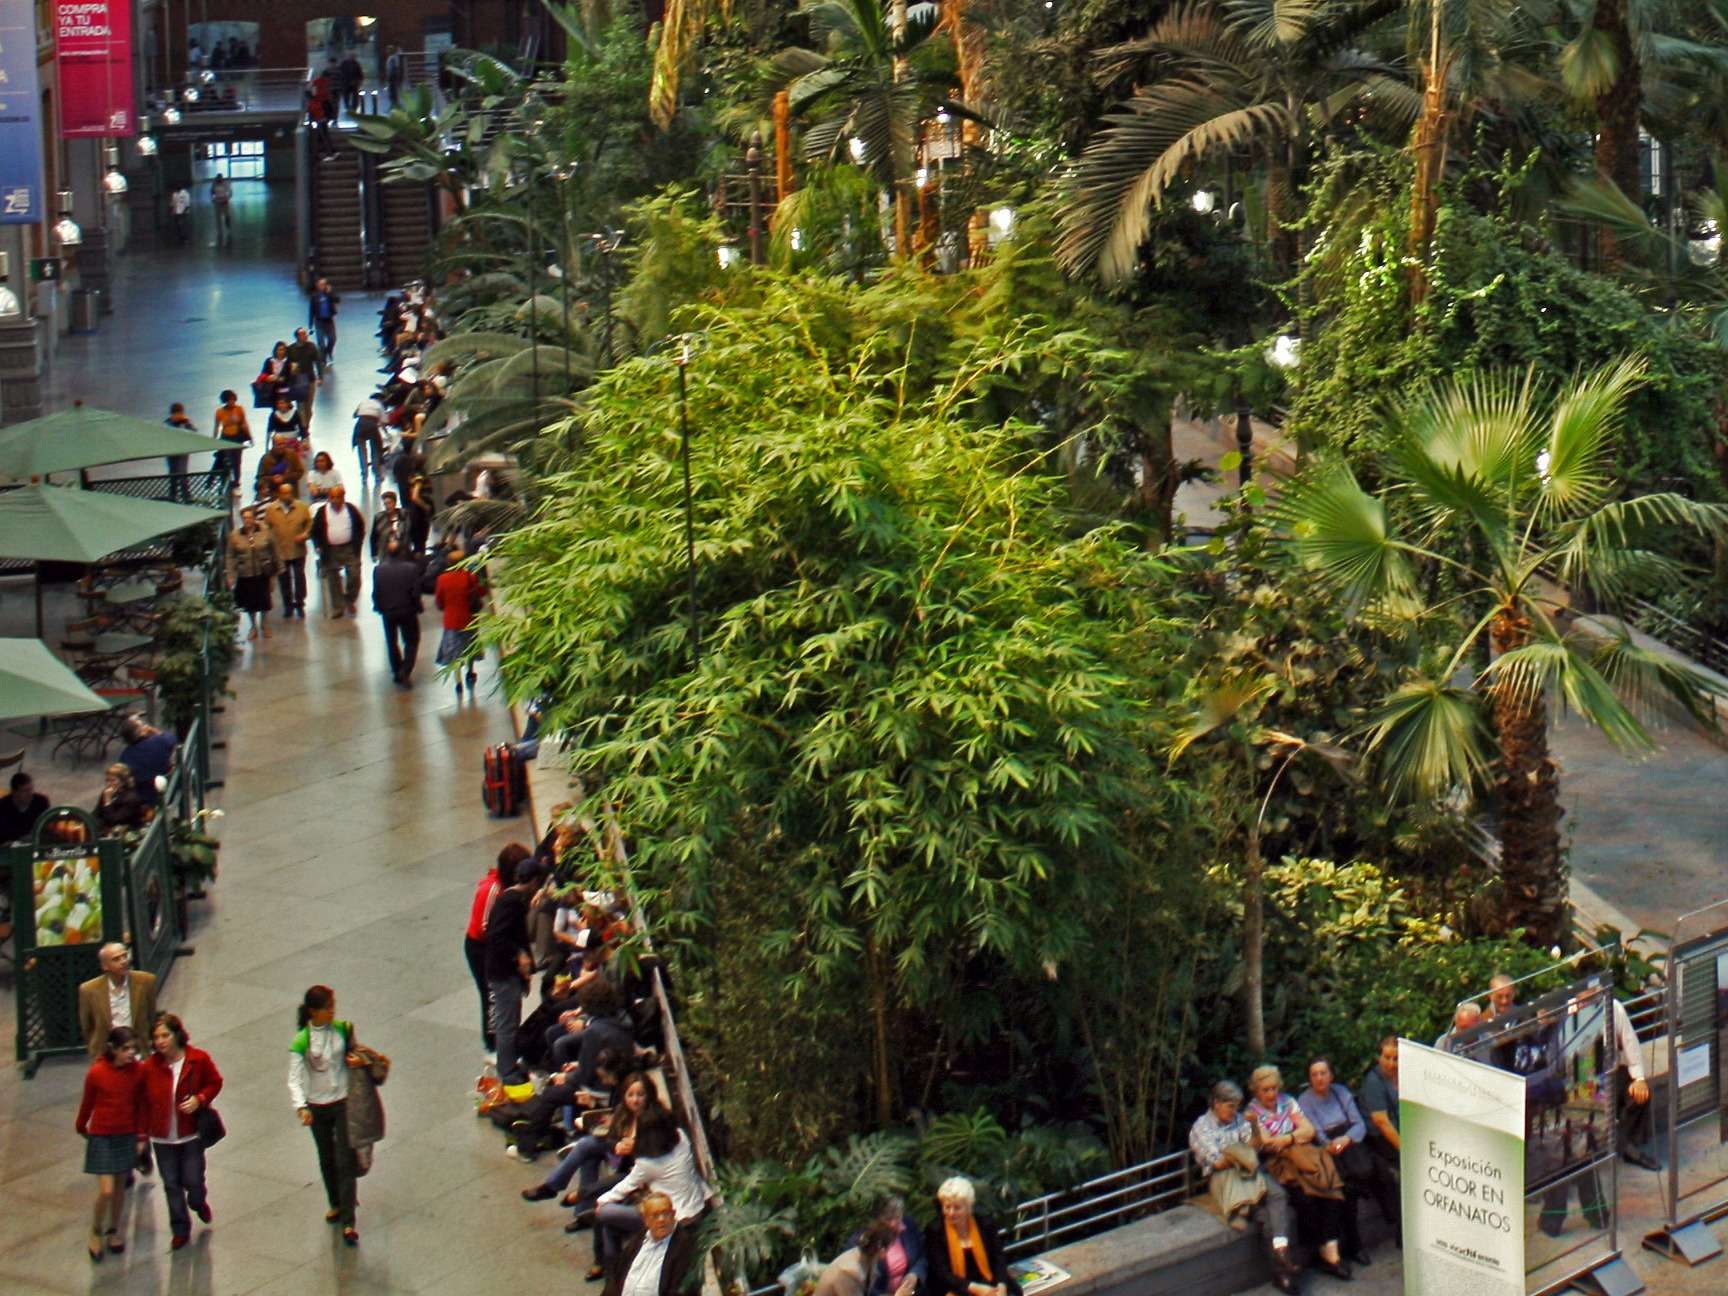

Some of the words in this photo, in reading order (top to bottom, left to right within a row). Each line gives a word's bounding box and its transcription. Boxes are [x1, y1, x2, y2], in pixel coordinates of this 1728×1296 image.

[59, 4, 108, 15] COMPRA
[59, 15, 73, 26] YA
[76, 14, 91, 25] TU
[60, 26, 111, 37] ENTRADA
[1428, 1140, 1503, 1181] Exposición
[1428, 1165, 1477, 1198] COLOR
[1481, 1184, 1505, 1206] EN
[1423, 1188, 1512, 1234] ORFANATOS
